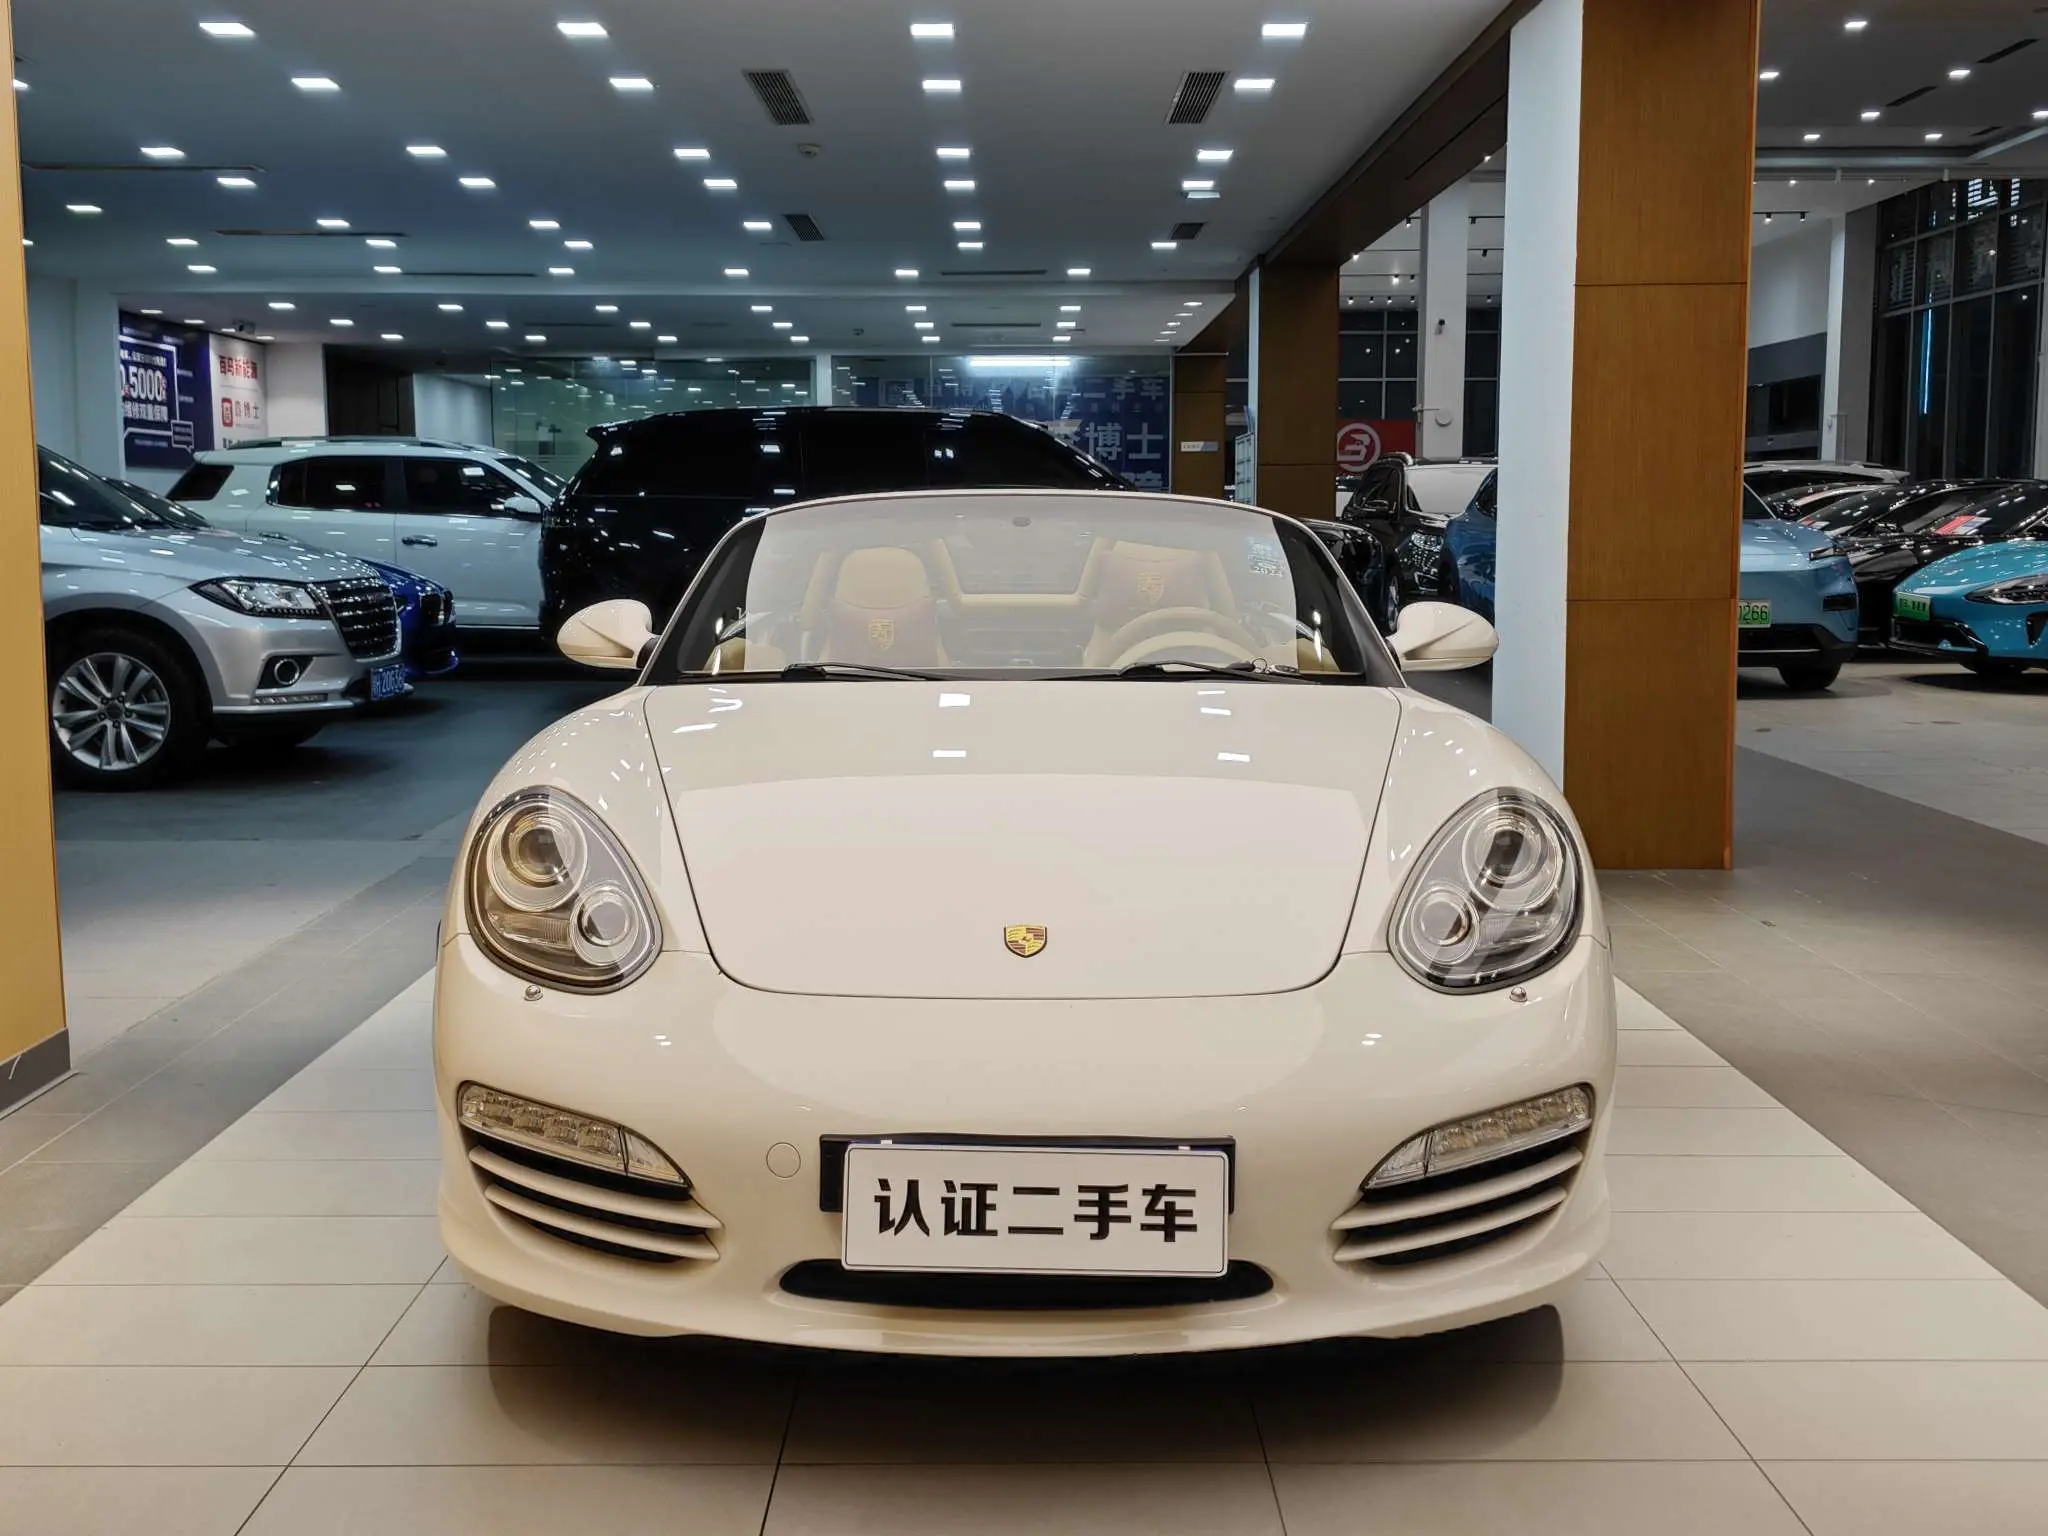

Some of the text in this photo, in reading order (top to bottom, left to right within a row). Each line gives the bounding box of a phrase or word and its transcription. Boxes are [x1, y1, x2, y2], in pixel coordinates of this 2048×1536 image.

[874, 1178, 1198, 1243] 认证二手车
